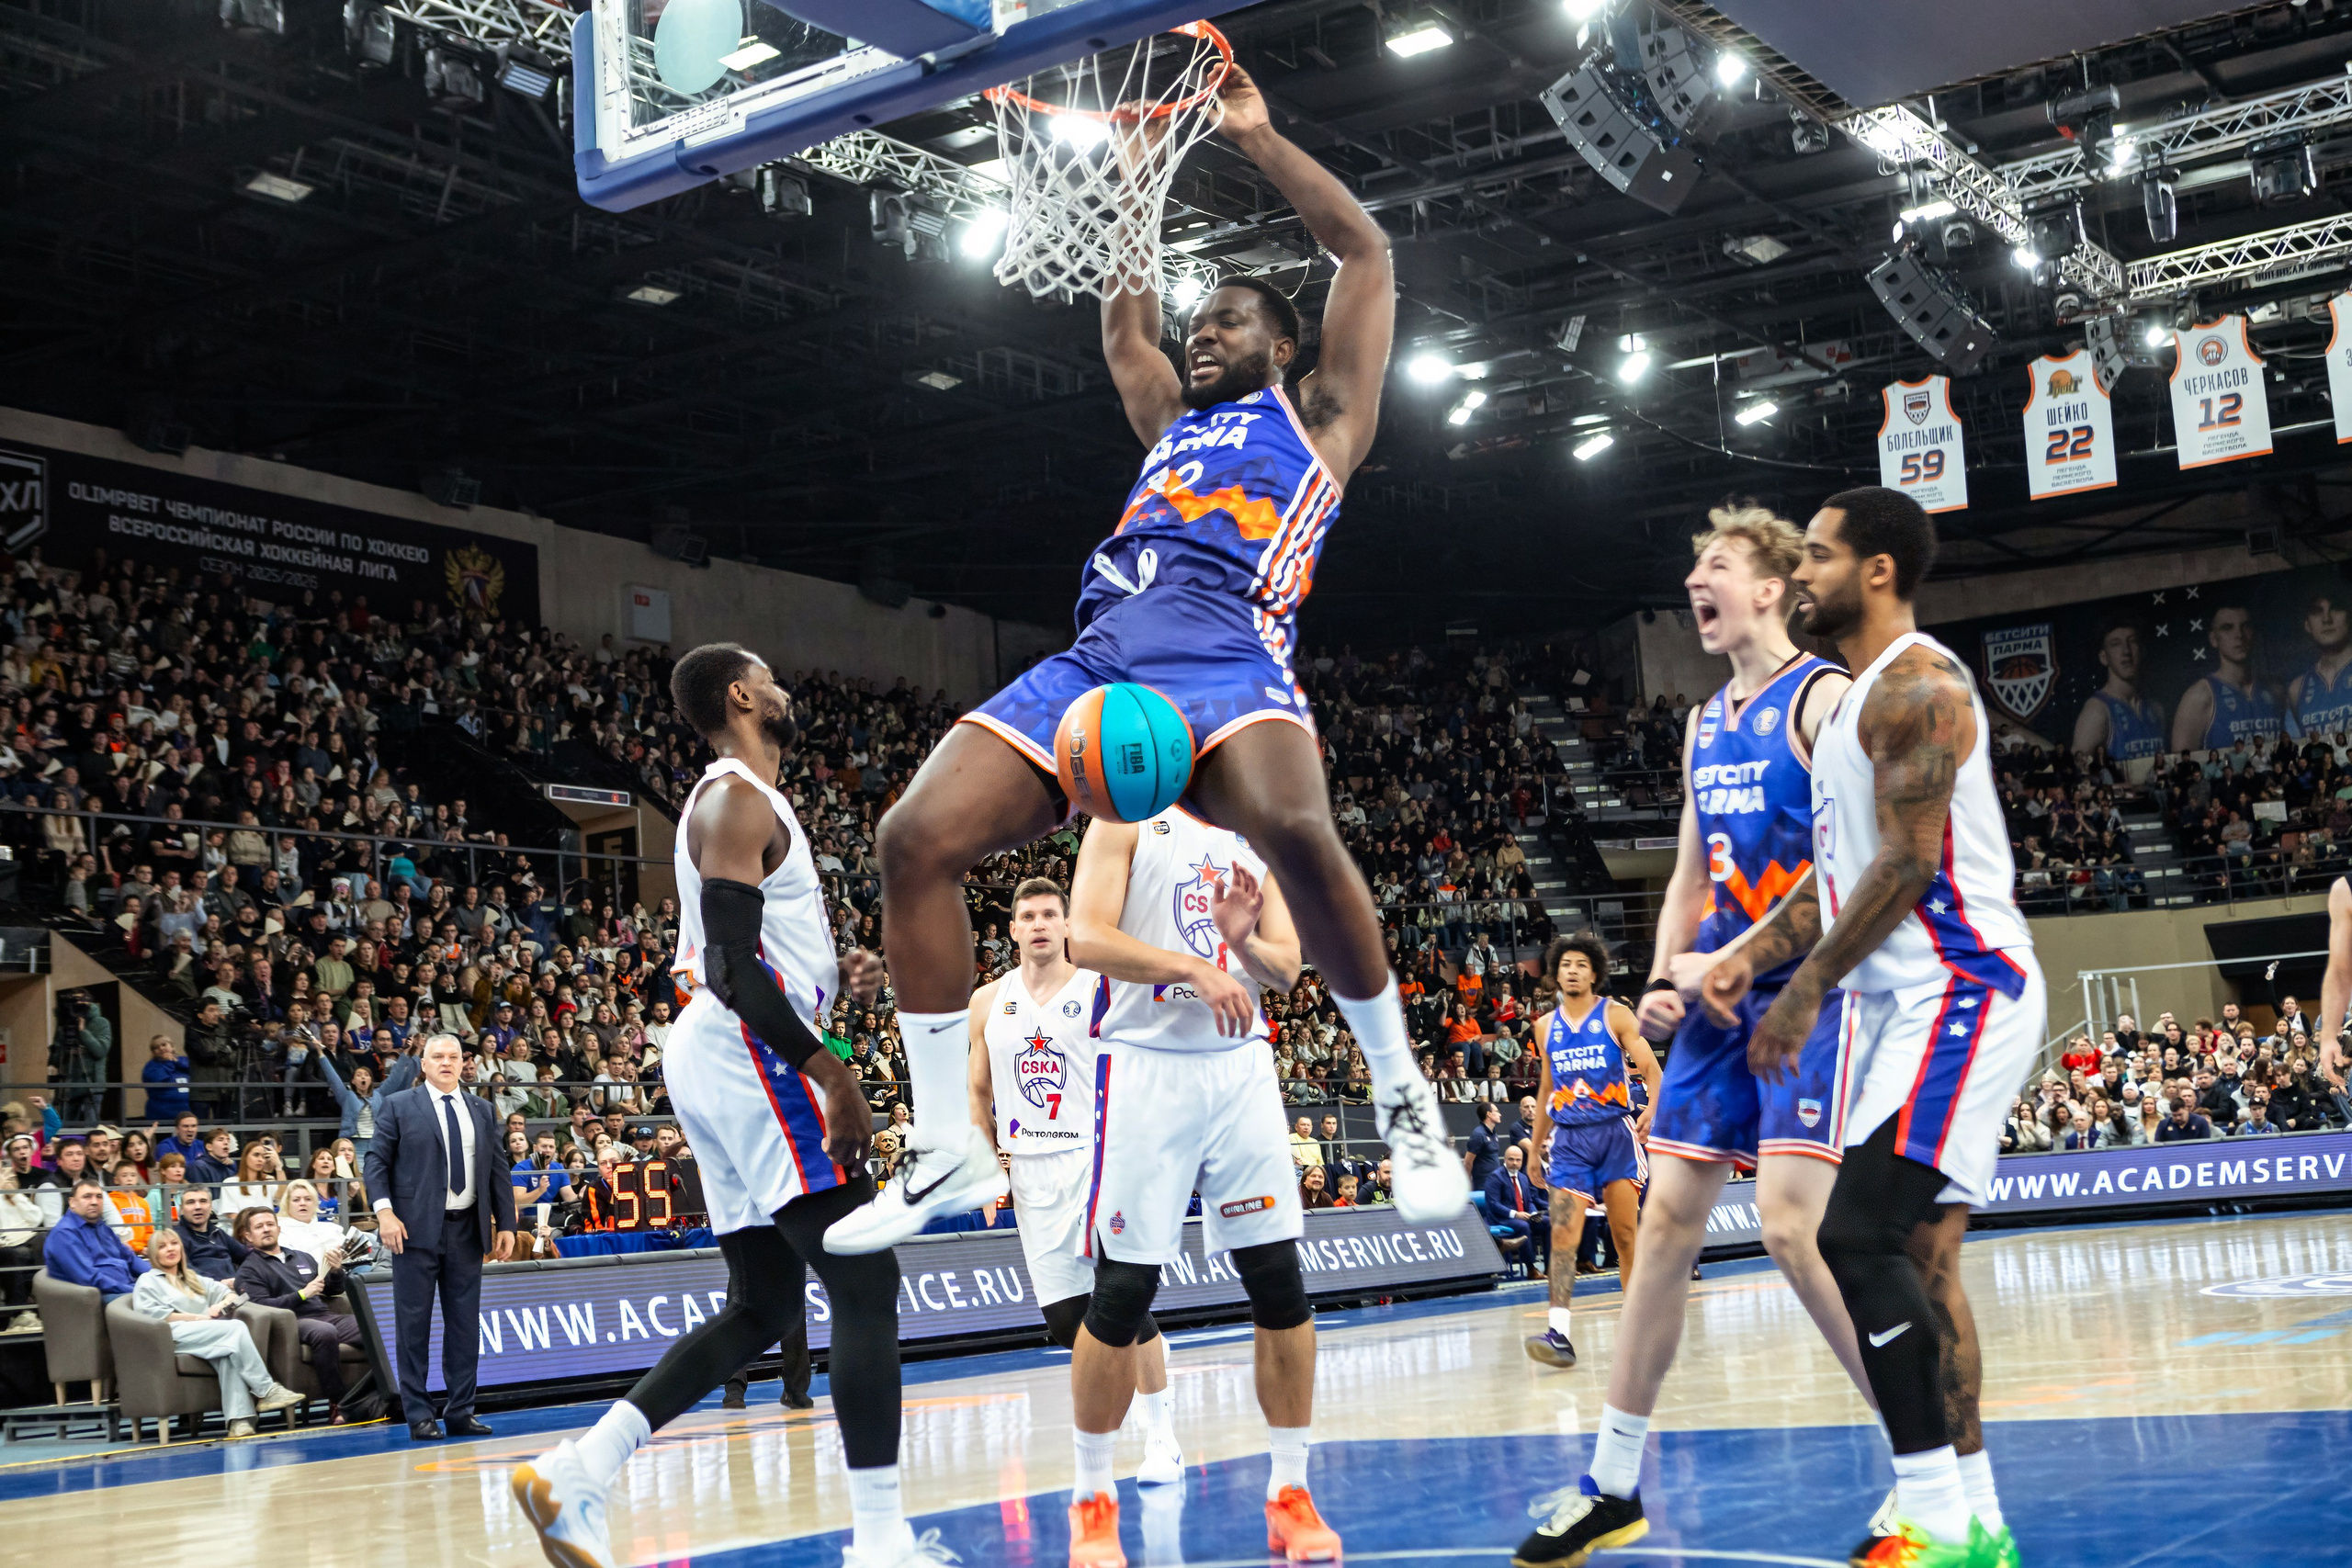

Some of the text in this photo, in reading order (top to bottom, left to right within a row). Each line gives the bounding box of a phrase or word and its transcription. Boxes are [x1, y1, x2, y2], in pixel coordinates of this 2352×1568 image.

[2184, 367, 2249, 396] ЧЕРКАСОВ
[2046, 401, 2088, 426] ШЕЙКО
[2198, 392, 2244, 433] 12
[1887, 425, 1954, 452] БОЛЕЛЬЩИК
[2045, 425, 2095, 466] 22
[1900, 448, 1945, 486] 59
[69, 481, 430, 564] OLIMPBET ЧЕМПИОНАТ РОССИИ ПО ХОККЕЮ
[108, 514, 398, 582] ВСЕРОССИЙСКАЯ ХОККЕЙНАЯ ЛИГА
[1984, 625, 2050, 643] БЕТСИТИ
[1993, 639, 2042, 655] ПАРМА
[2229, 717, 2281, 733] BETCITY
[1551, 1043, 1606, 1062] BETCITY
[1554, 1055, 1608, 1074] PARMA
[1021, 1060, 1060, 1074] CSKA
[1046, 1093, 1062, 1121] 7
[612, 1161, 673, 1229] 55
